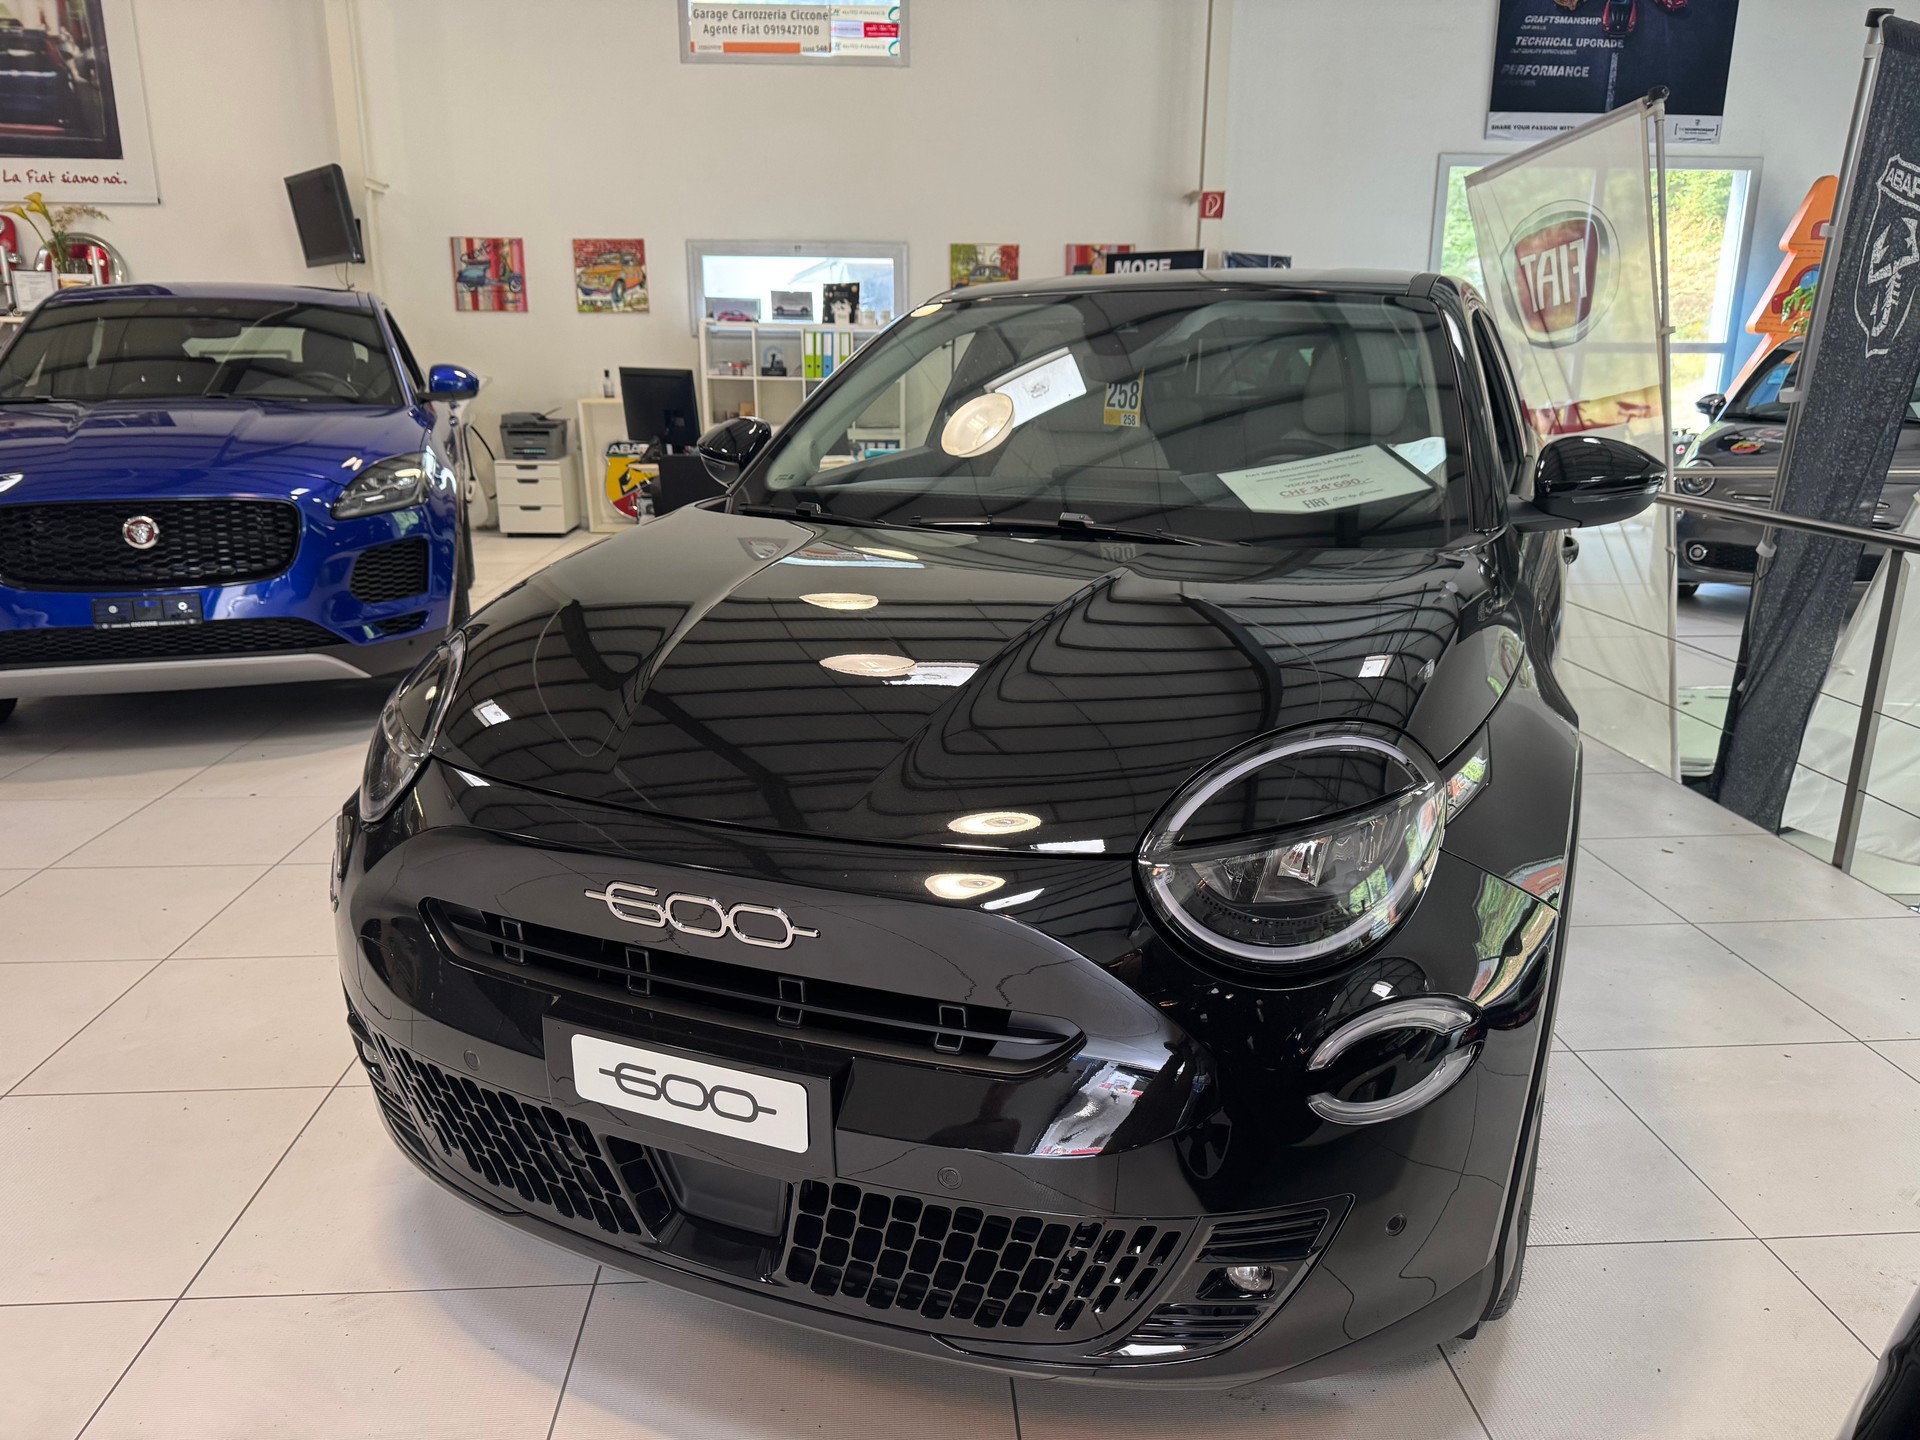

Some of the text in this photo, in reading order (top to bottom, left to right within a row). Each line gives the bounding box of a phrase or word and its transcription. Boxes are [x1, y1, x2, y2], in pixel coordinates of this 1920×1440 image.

[693, 9, 829, 21] Garage Carrozzeria Ciccone
[1524, 15, 1602, 25] CRAFTSMANSHIP
[703, 24, 819, 36] Agente Fiat 0919427108
[1515, 36, 1624, 48] TECHNICAL UPGRADE
[1501, 64, 1589, 77] PERFORMANCE
[3, 169, 127, 184] La Fiat siamo noi.
[1114, 258, 1172, 273] MORE
[1106, 381, 1139, 410] 258
[1123, 414, 1136, 426] 258
[1280, 487, 1307, 497] CHF
[1302, 497, 1330, 509] FIAT
